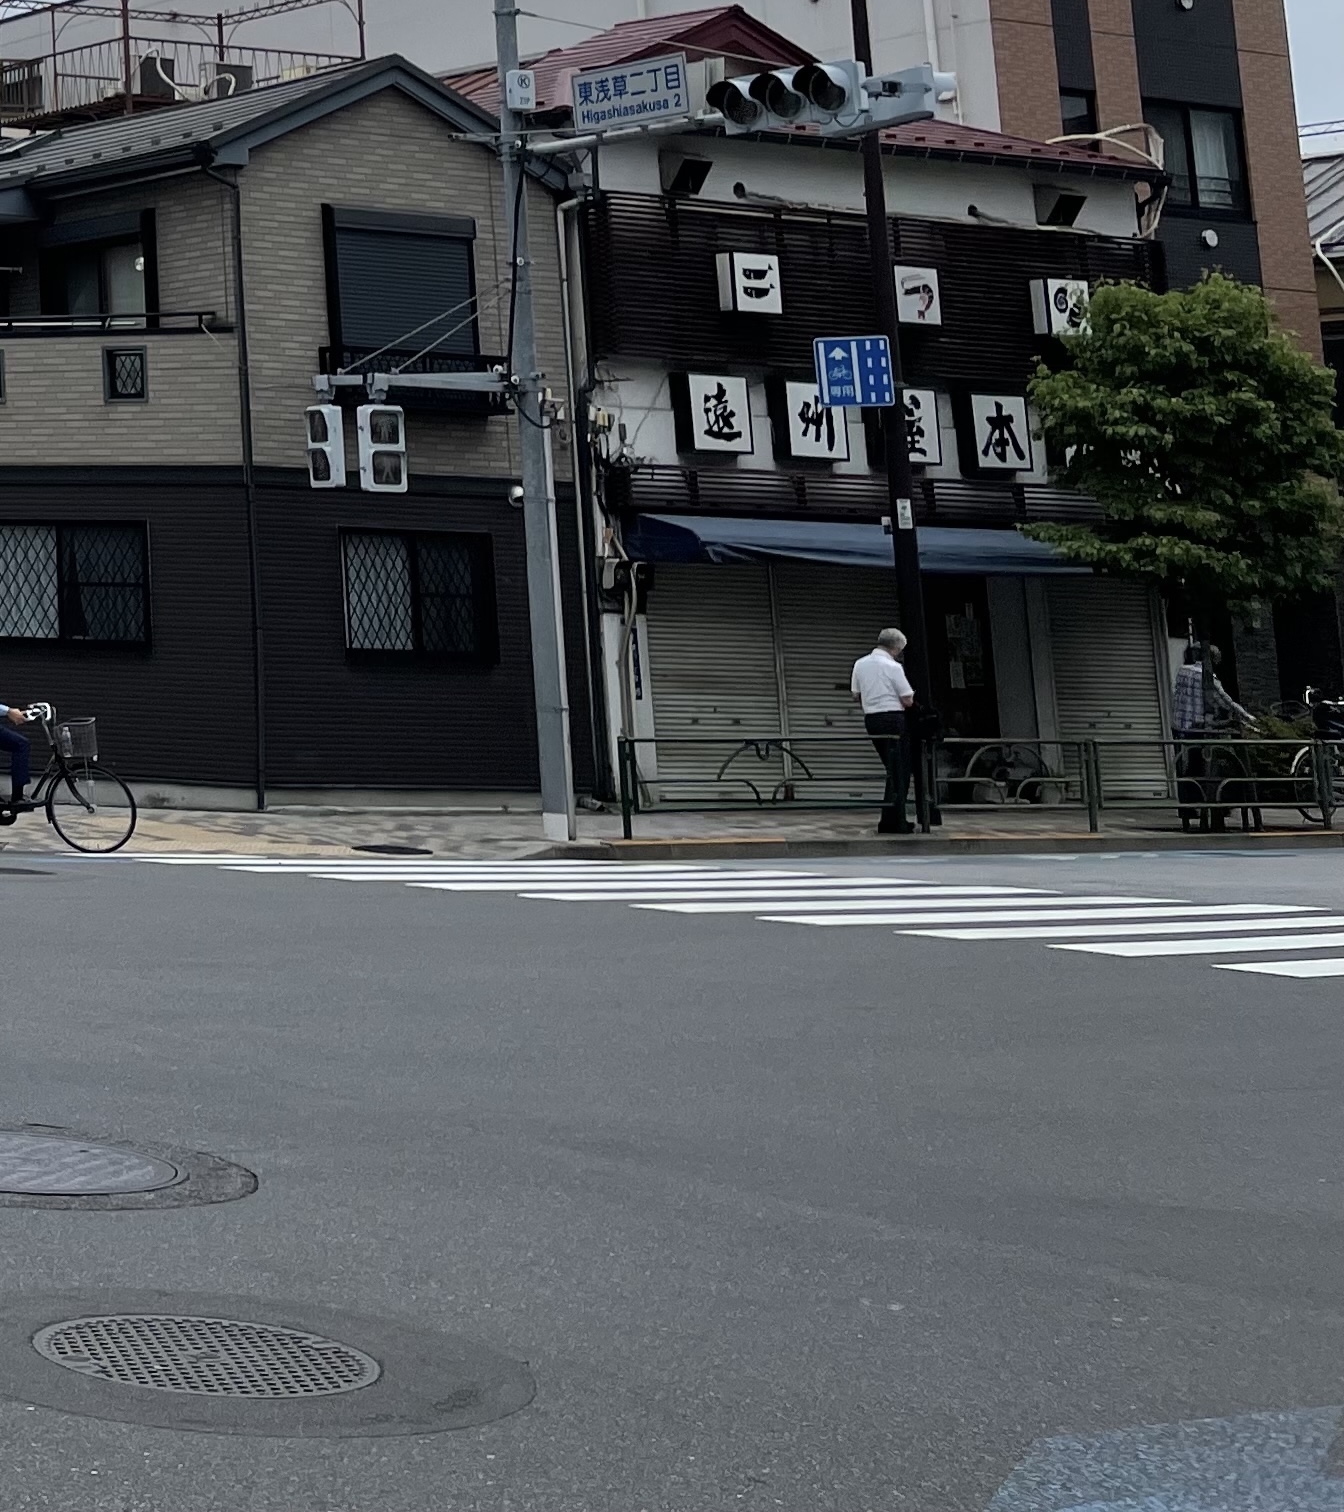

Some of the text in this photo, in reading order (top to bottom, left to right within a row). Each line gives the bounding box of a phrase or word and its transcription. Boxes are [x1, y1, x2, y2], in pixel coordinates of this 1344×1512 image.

[578, 63, 681, 106] 東浅草二丁目
[582, 94, 682, 124] Higashiasakusa 2
